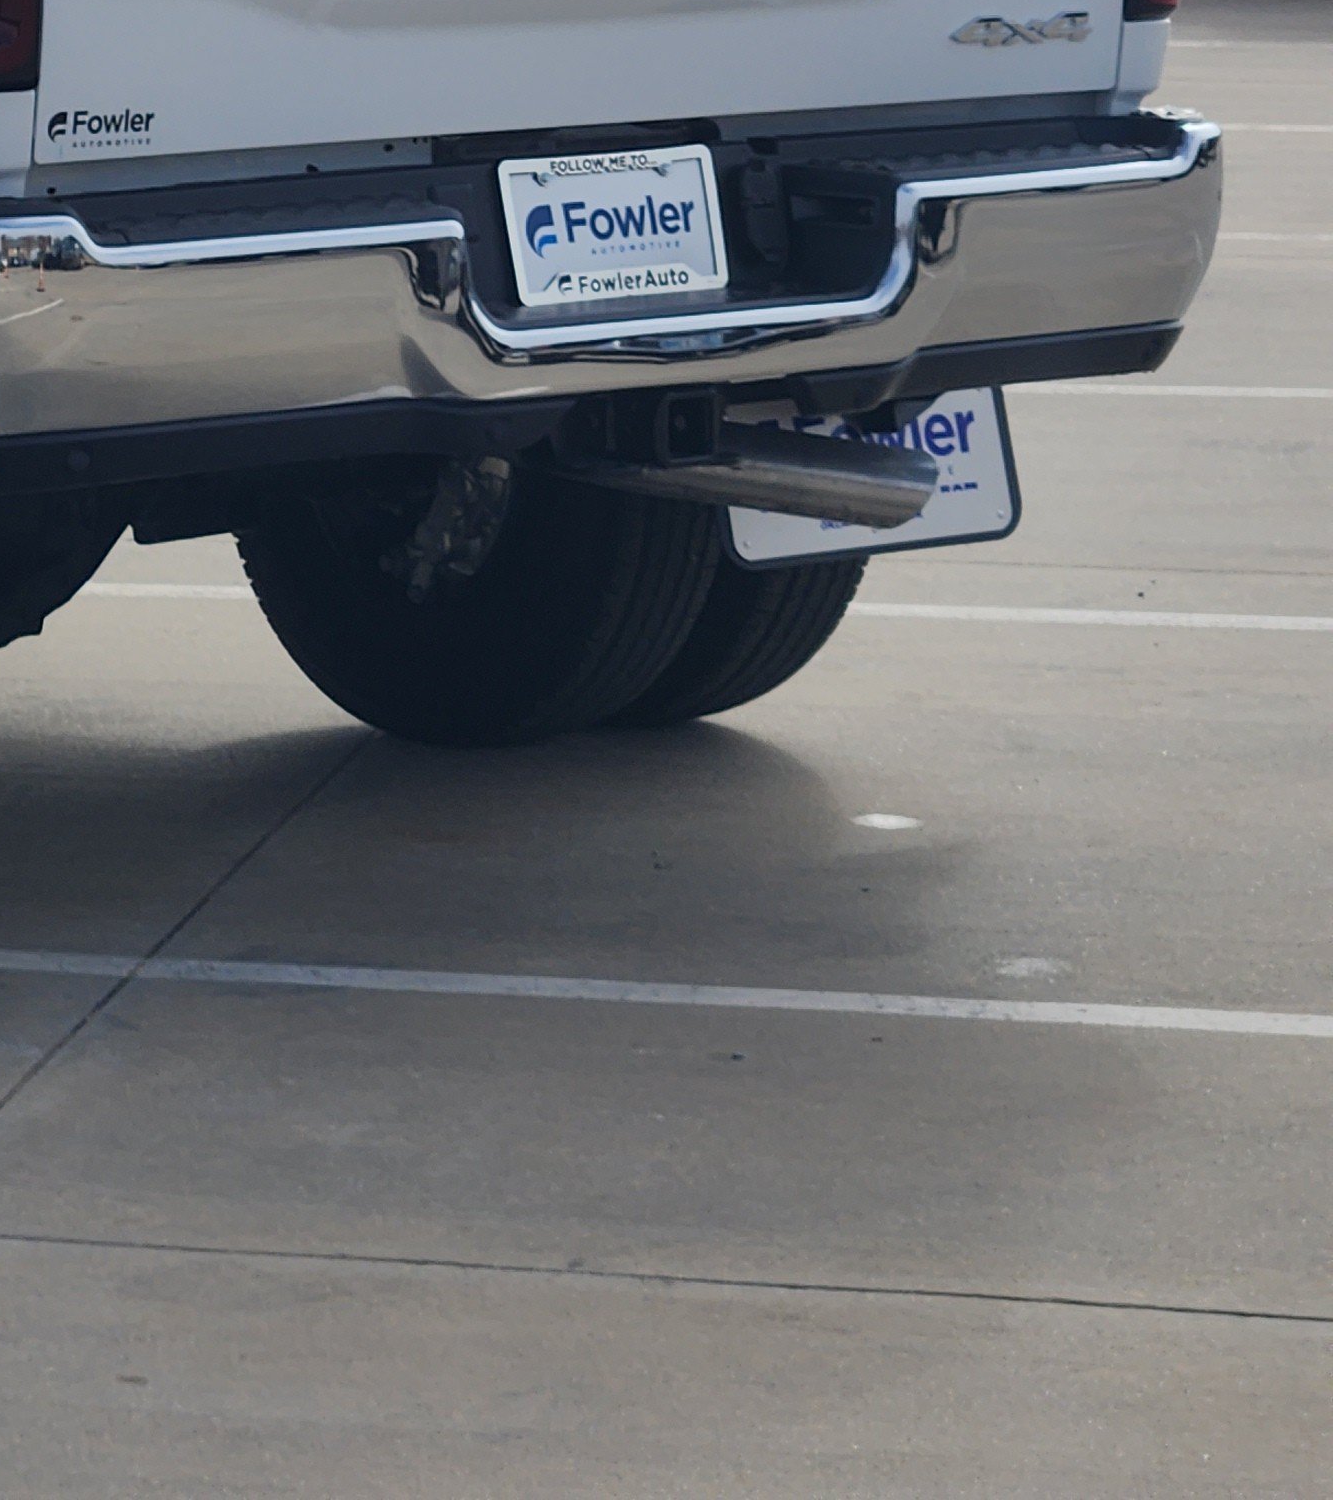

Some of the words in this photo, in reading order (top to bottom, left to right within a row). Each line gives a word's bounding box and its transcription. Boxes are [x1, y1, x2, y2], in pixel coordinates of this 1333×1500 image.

[948, 11, 1093, 46] 4x4
[72, 107, 155, 135] Fowler
[72, 137, 152, 148] AUTOMOTIVE
[550, 157, 604, 173] FOLLOW
[609, 156, 627, 168] ME
[561, 194, 695, 243] Fowler
[591, 240, 681, 255] AUTOMOTIVE
[578, 267, 690, 294] FowlerAuto
